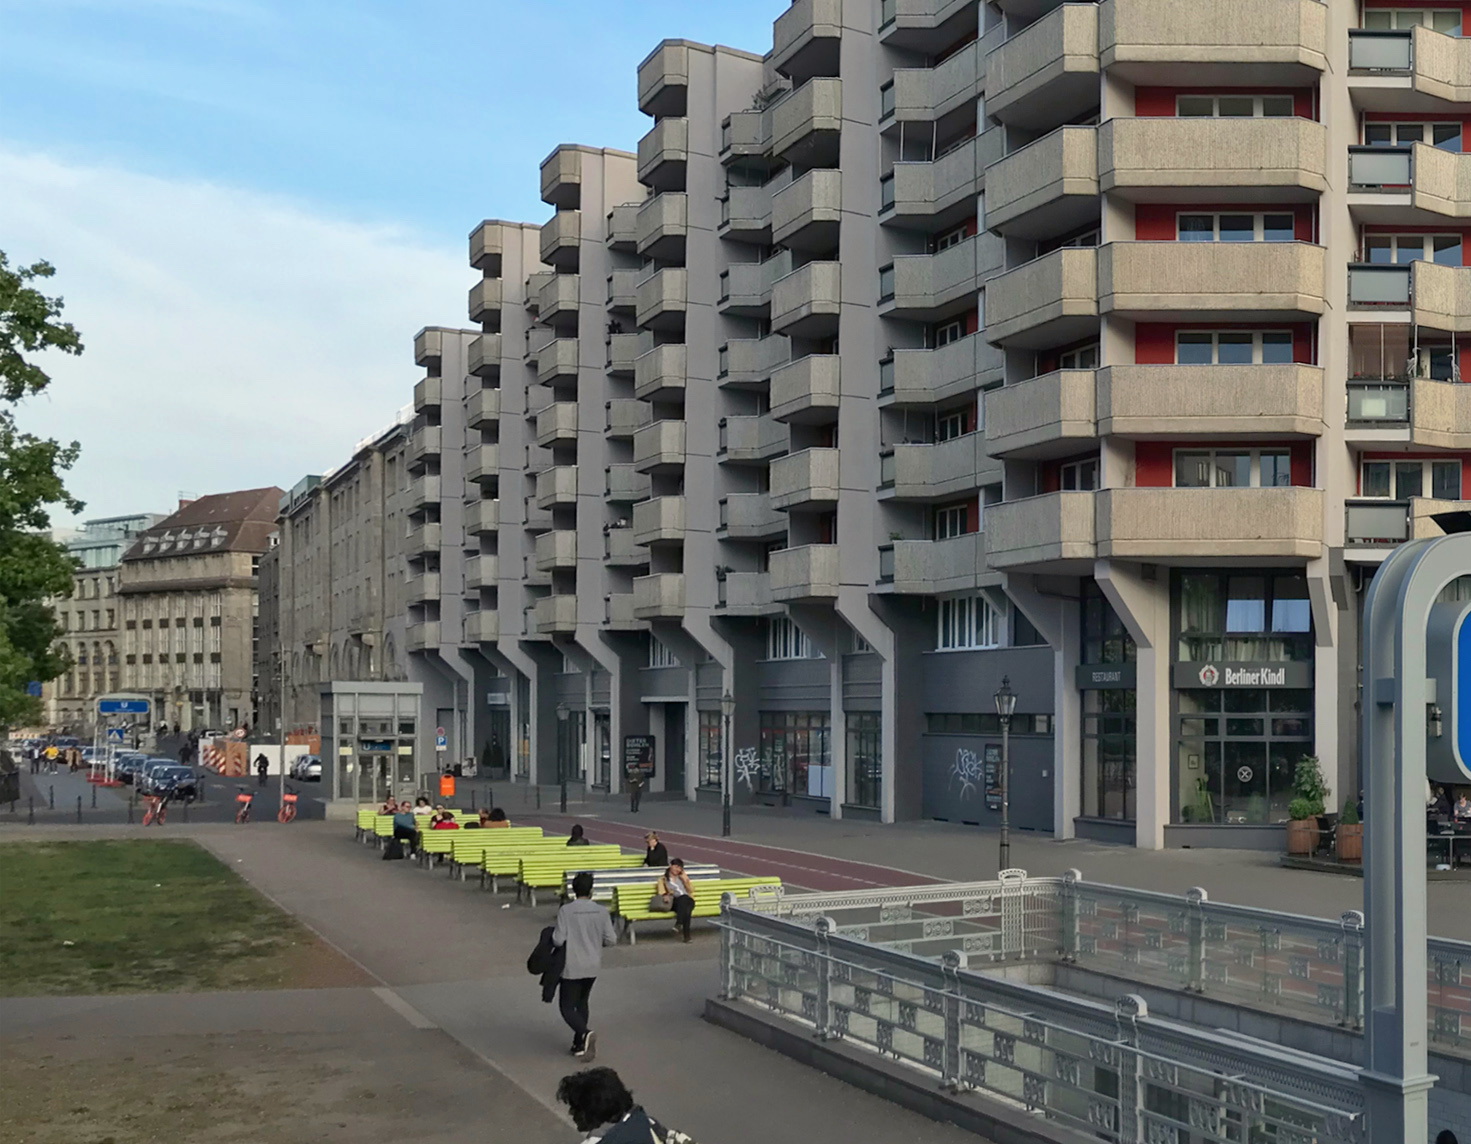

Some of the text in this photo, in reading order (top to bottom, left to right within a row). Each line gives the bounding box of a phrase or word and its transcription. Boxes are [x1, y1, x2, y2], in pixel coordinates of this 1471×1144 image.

[1092, 671, 1121, 682] RESTAURANT
[1225, 668, 1285, 685] Berliner Kindl
[438, 737, 445, 745] P
